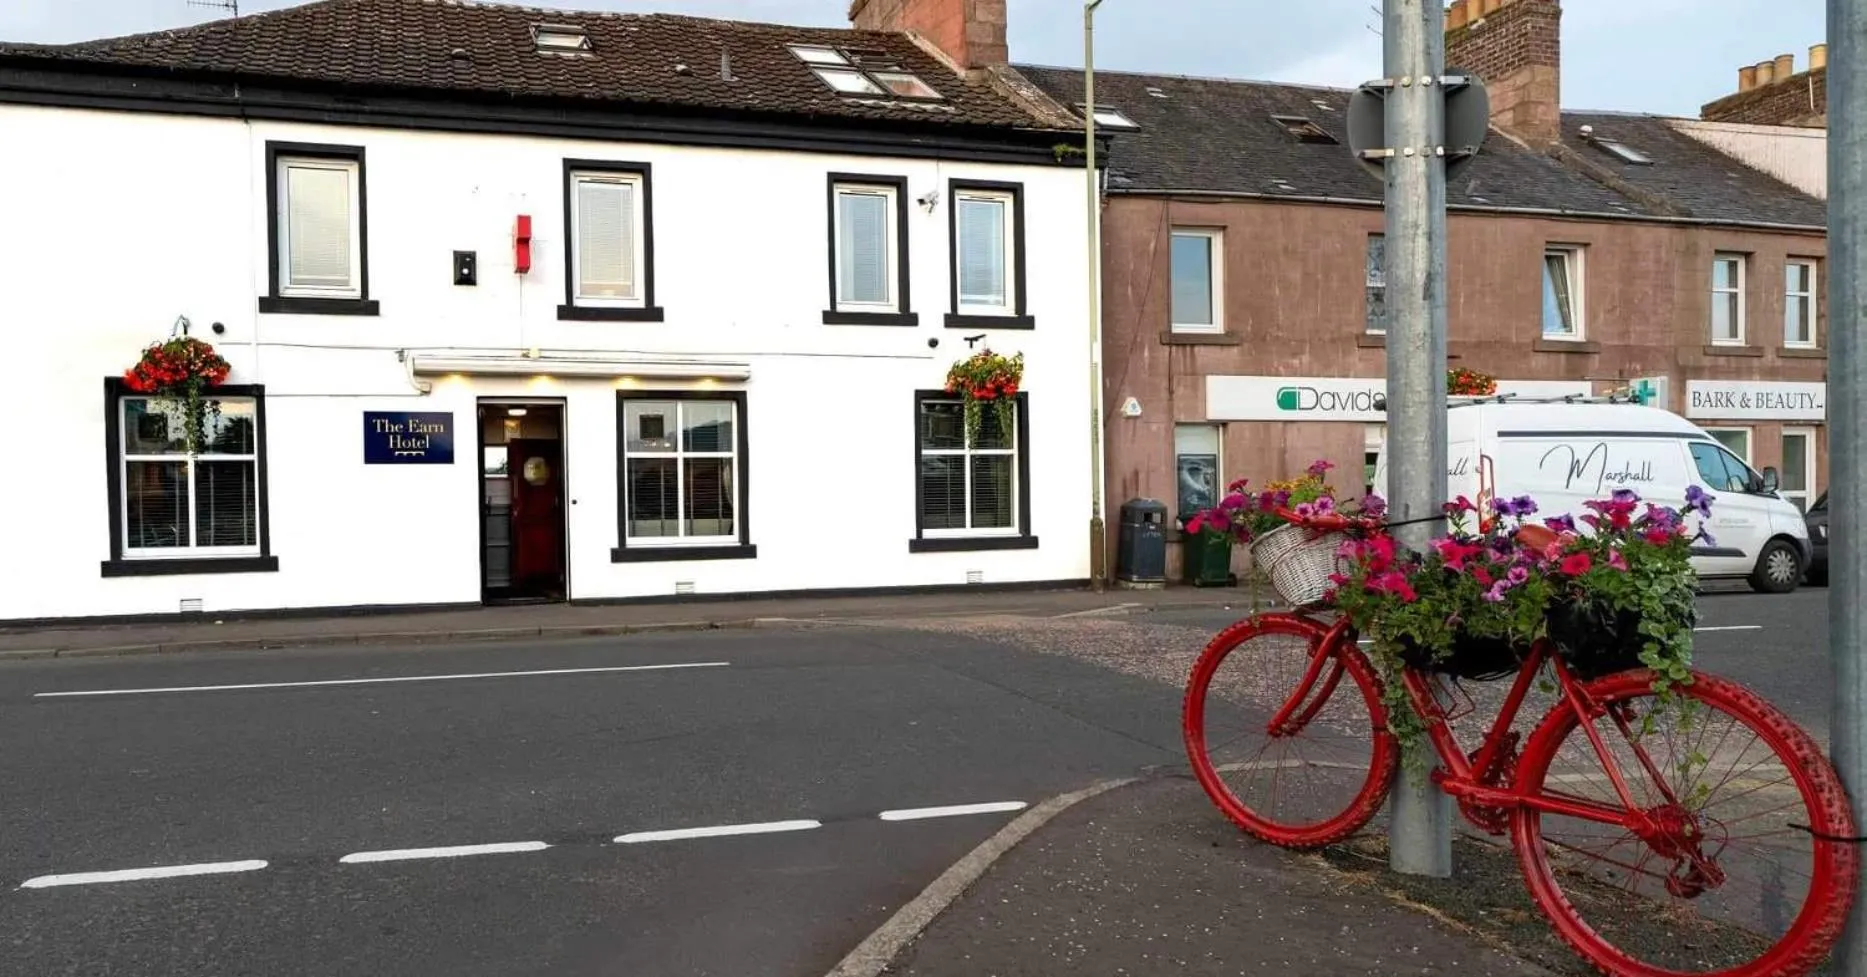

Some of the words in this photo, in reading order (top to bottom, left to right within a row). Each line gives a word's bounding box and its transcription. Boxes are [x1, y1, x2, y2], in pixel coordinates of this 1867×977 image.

[1692, 391, 1735, 408] BARK
[1739, 392, 1751, 408] &
[1755, 392, 1816, 409] BEAUTY
[372, 419, 404, 433] The
[408, 419, 444, 433] Earn
[389, 434, 429, 448] Hotel
[1539, 442, 1654, 494] Marshall
